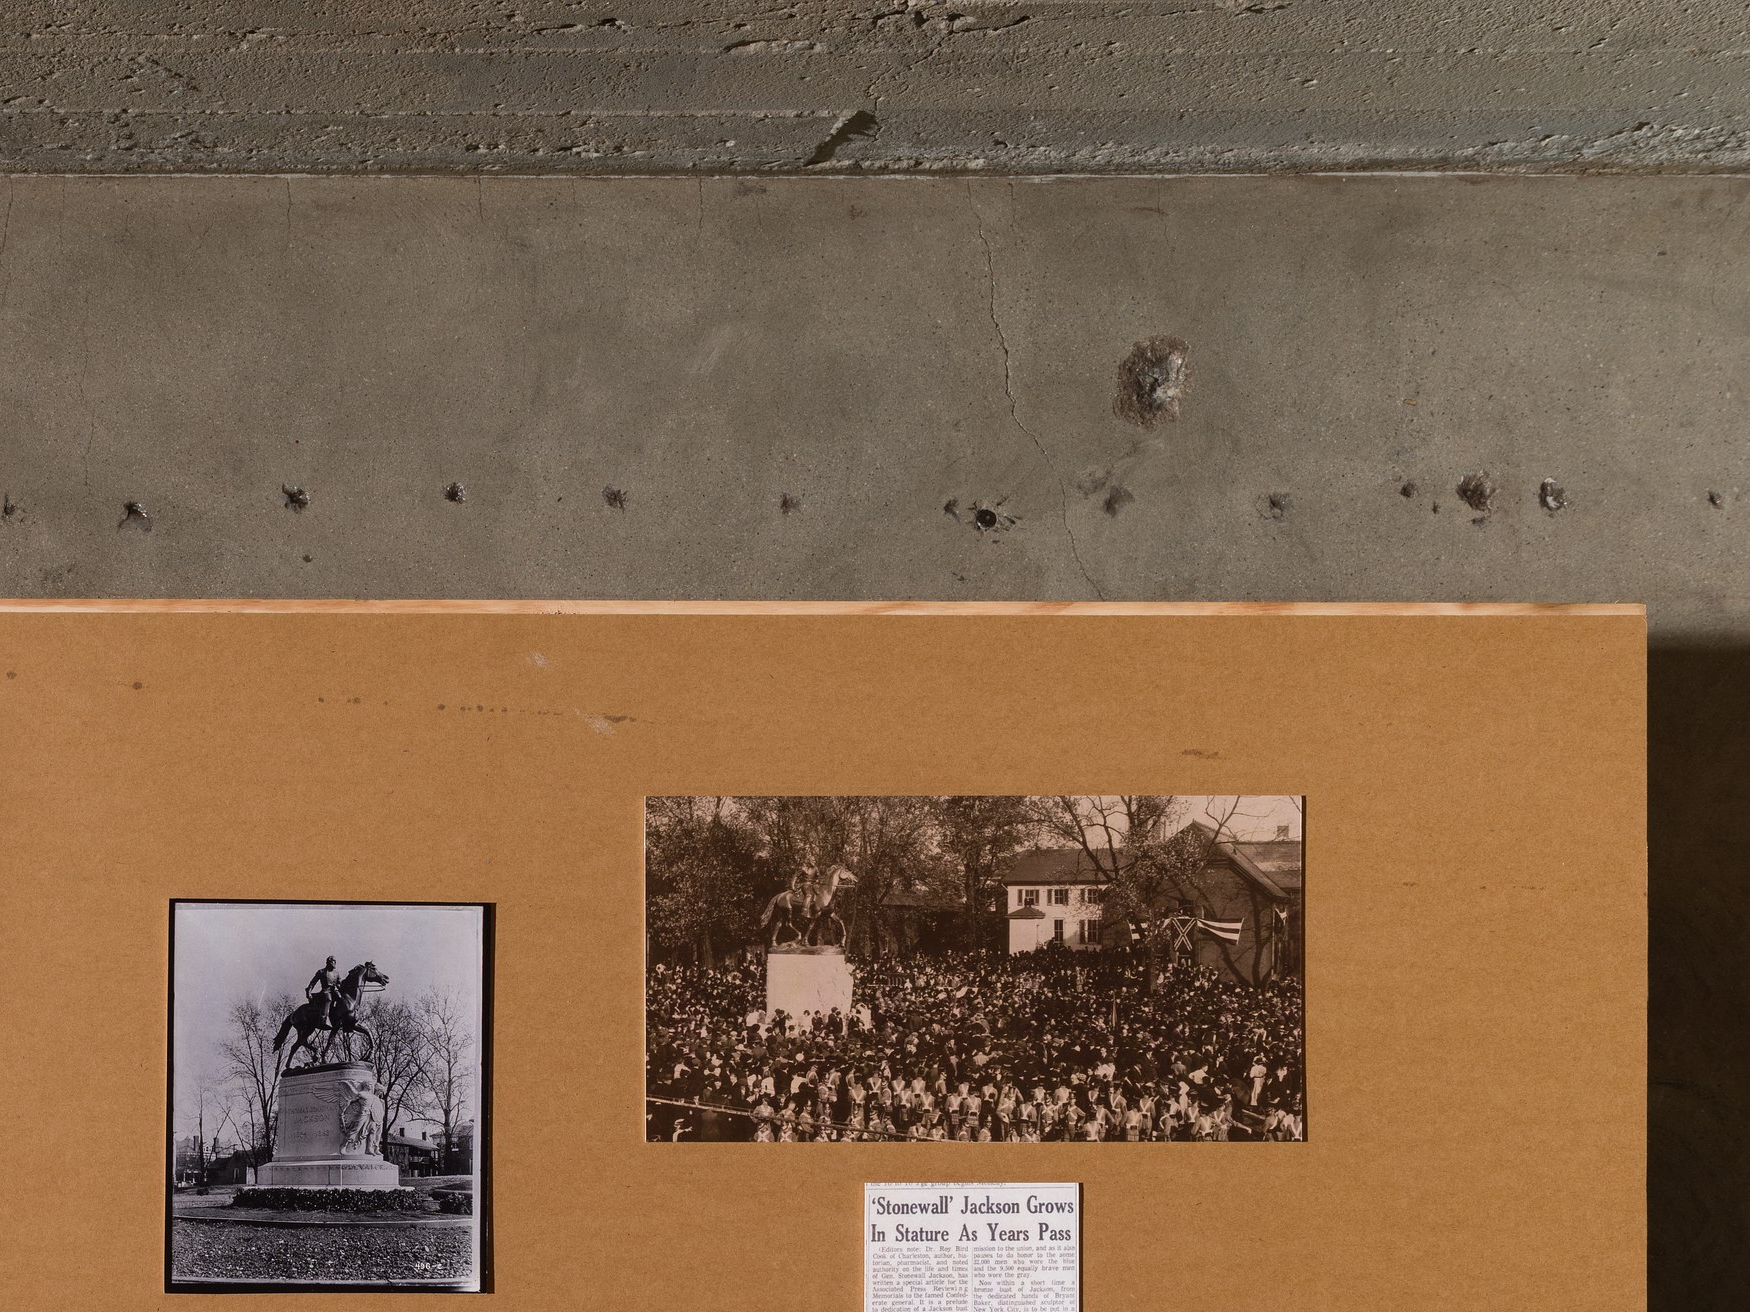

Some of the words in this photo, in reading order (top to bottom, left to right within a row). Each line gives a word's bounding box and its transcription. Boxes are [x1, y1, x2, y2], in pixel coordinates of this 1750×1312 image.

[872, 1195, 954, 1215] ‘Stonewall’
[960, 1195, 1020, 1215] Jackson
[1026, 1195, 1074, 1214] Grows
[871, 1224, 886, 1243] In
[895, 1223, 949, 1242] Stature
[958, 1223, 978, 1242] As
[986, 1223, 1030, 1242] Years
[1038, 1222, 1072, 1241] Pass
